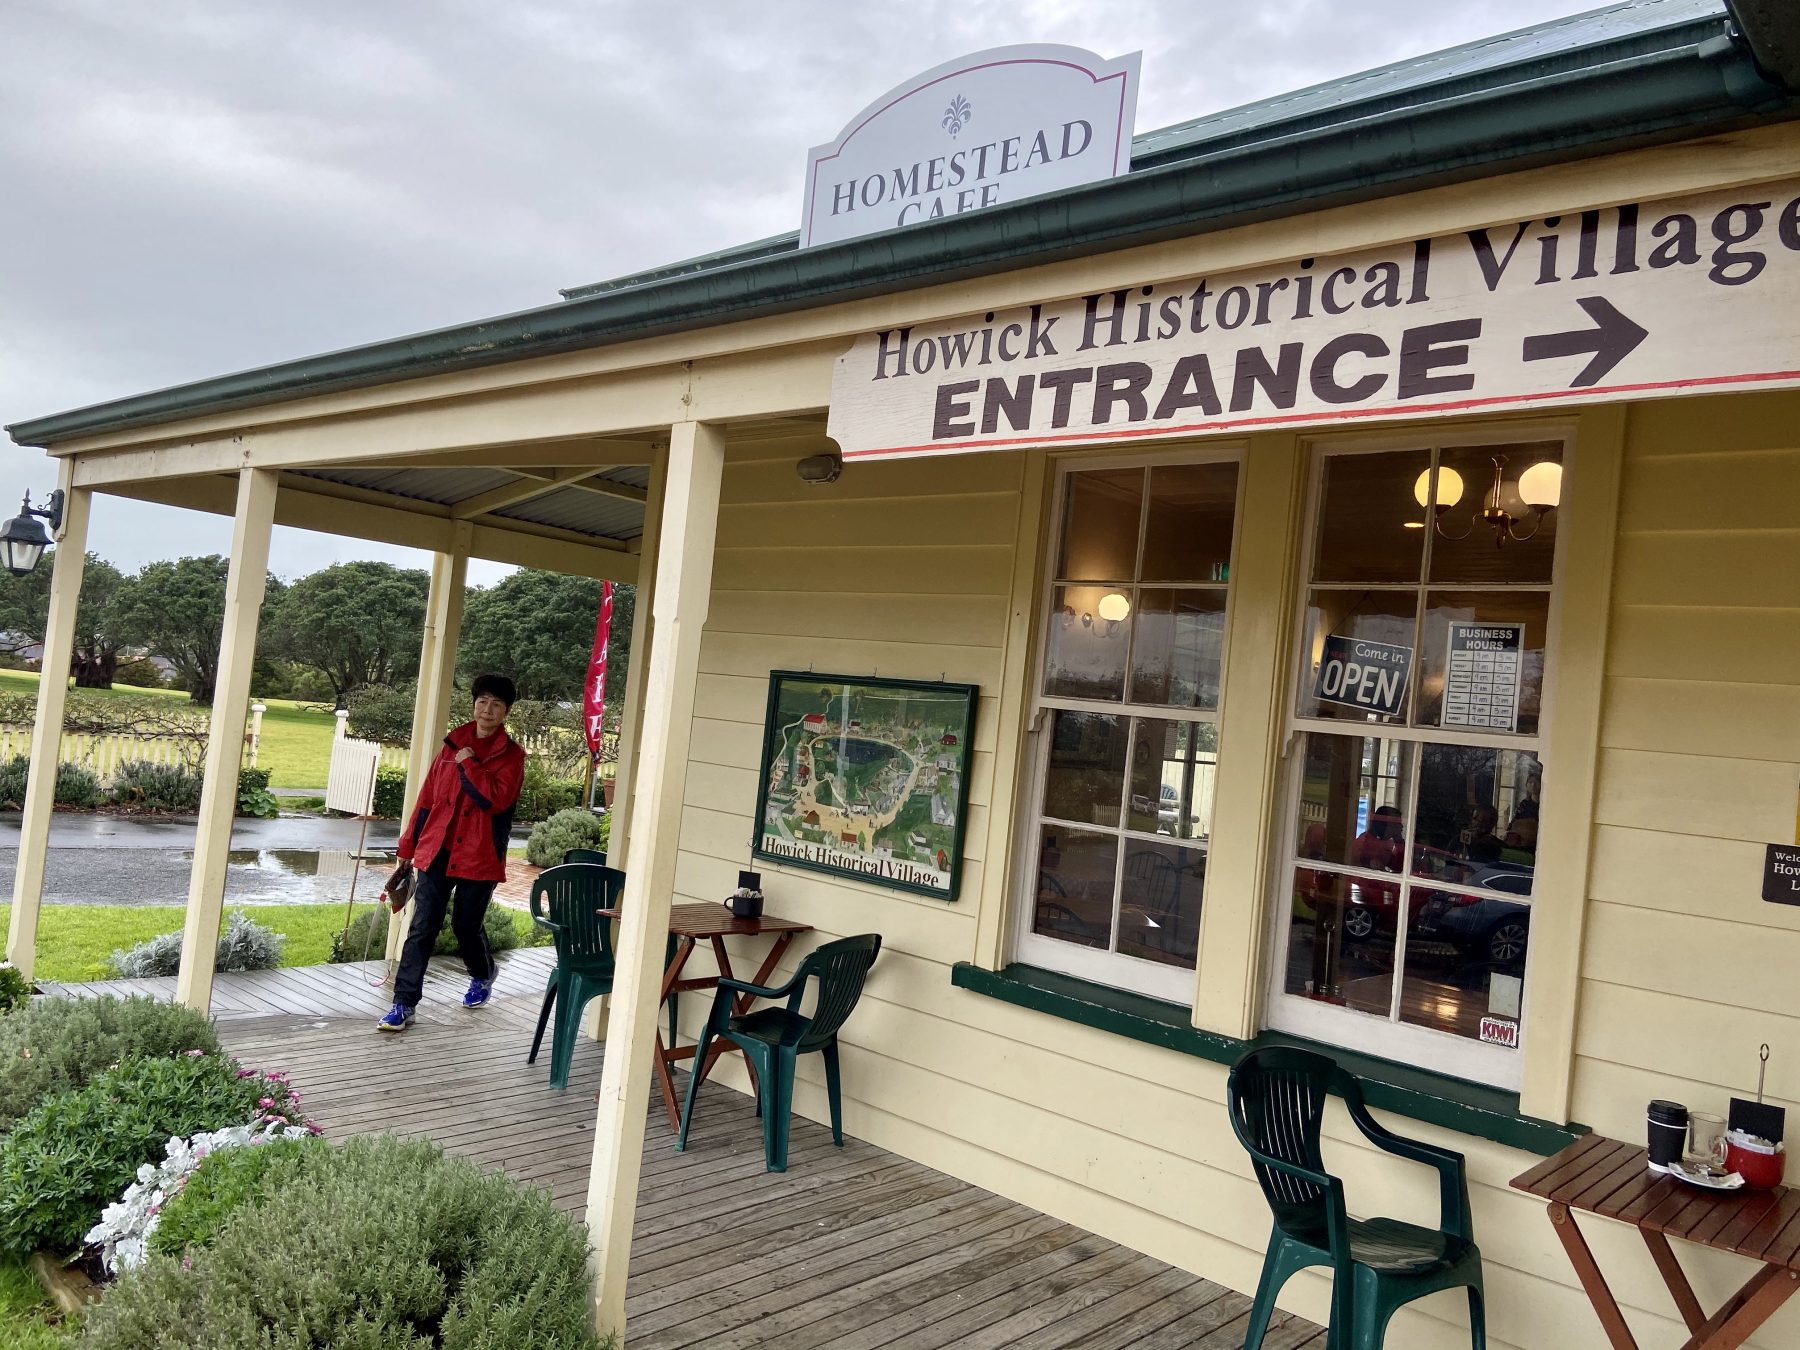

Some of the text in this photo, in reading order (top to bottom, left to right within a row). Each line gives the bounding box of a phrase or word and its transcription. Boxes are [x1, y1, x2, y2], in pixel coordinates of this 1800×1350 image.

[830, 119, 1093, 217] HOMESTEAD
[872, 305, 1060, 381] Howick
[1076, 238, 1431, 352] Historical
[932, 318, 1482, 440] ENTRANCE
[1355, 643, 1405, 664] Come in
[1459, 628, 1513, 639] BUSINESS
[1466, 640, 1504, 650] HOURS
[1322, 659, 1400, 708] OPEN
[765, 836, 939, 887] Howick Historical Village
[1482, 1021, 1515, 1041] KIWI
